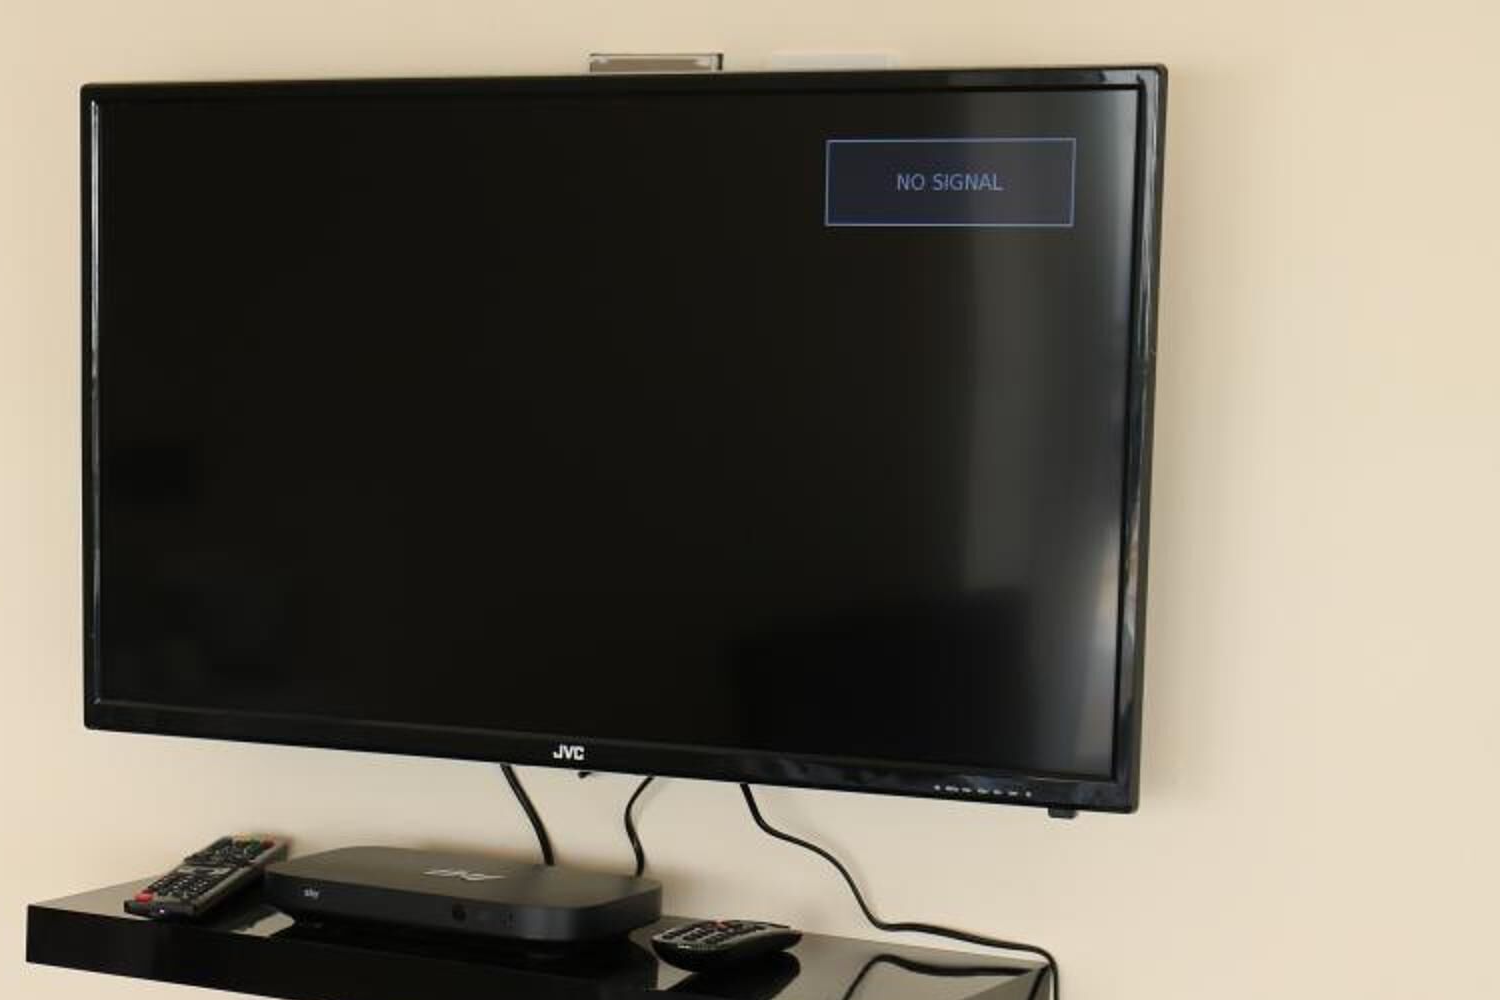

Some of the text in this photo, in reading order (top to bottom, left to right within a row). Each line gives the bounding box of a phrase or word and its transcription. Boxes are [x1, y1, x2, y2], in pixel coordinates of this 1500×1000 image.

[896, 173, 1004, 192] NO SIGNAL
[552, 743, 585, 761] JVC
